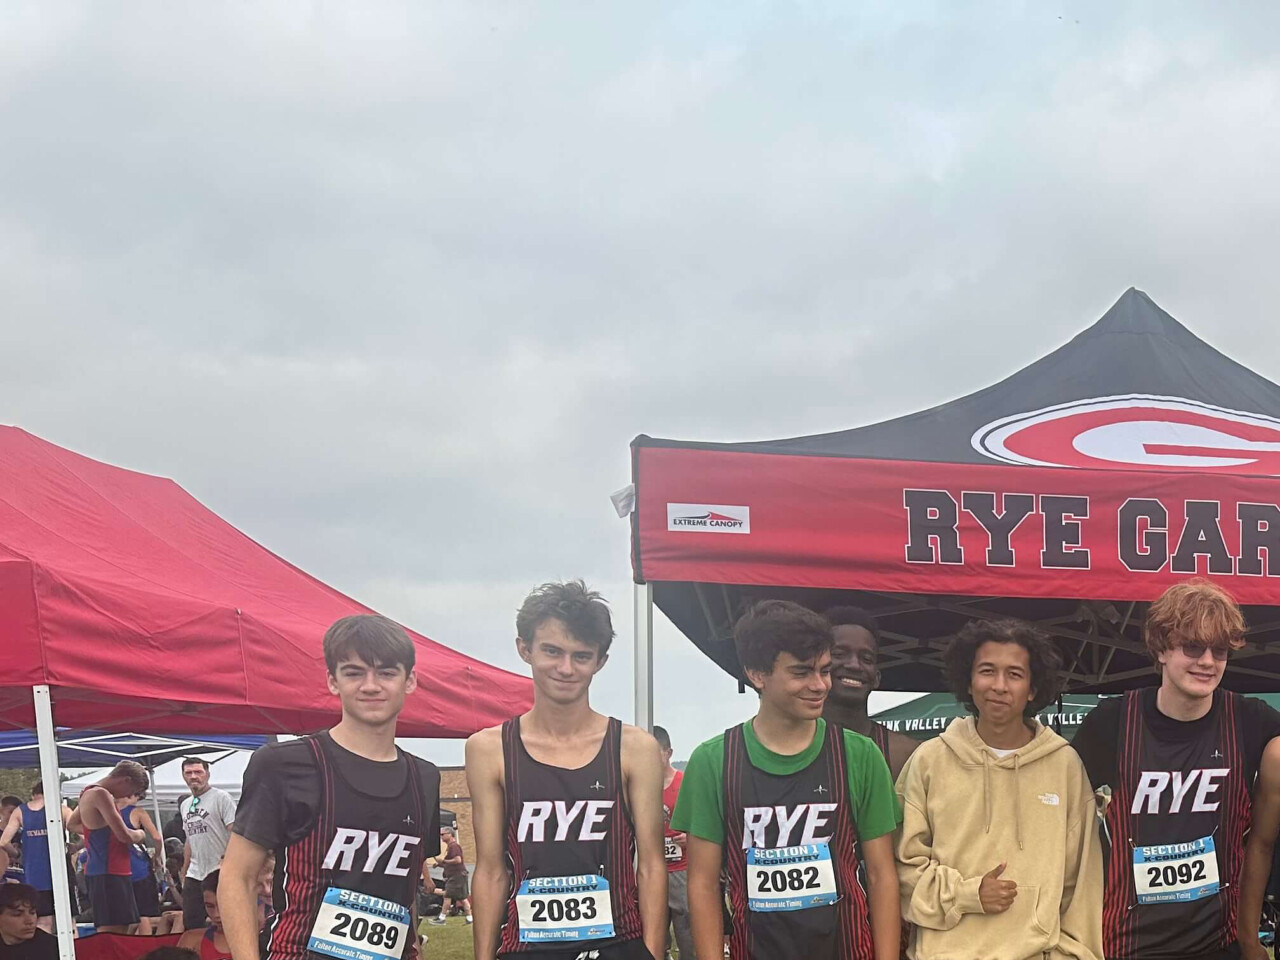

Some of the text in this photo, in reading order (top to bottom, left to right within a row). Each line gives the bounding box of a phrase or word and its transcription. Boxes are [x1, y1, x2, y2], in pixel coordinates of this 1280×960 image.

[903, 489, 1090, 570] RYE
[905, 717, 947, 731] VALLEY
[1131, 768, 1230, 814] RYE
[518, 801, 615, 842] RYE
[742, 803, 838, 849] RYE
[321, 827, 421, 876] RYE
[755, 847, 808, 858] SECTION
[1143, 841, 1196, 855] SECTION
[528, 876, 588, 886] SECTION
[757, 867, 820, 892] 2082
[1147, 860, 1206, 887] 2092
[339, 889, 401, 912] SECTION
[531, 897, 597, 922] 2083
[330, 913, 398, 949] 2089
